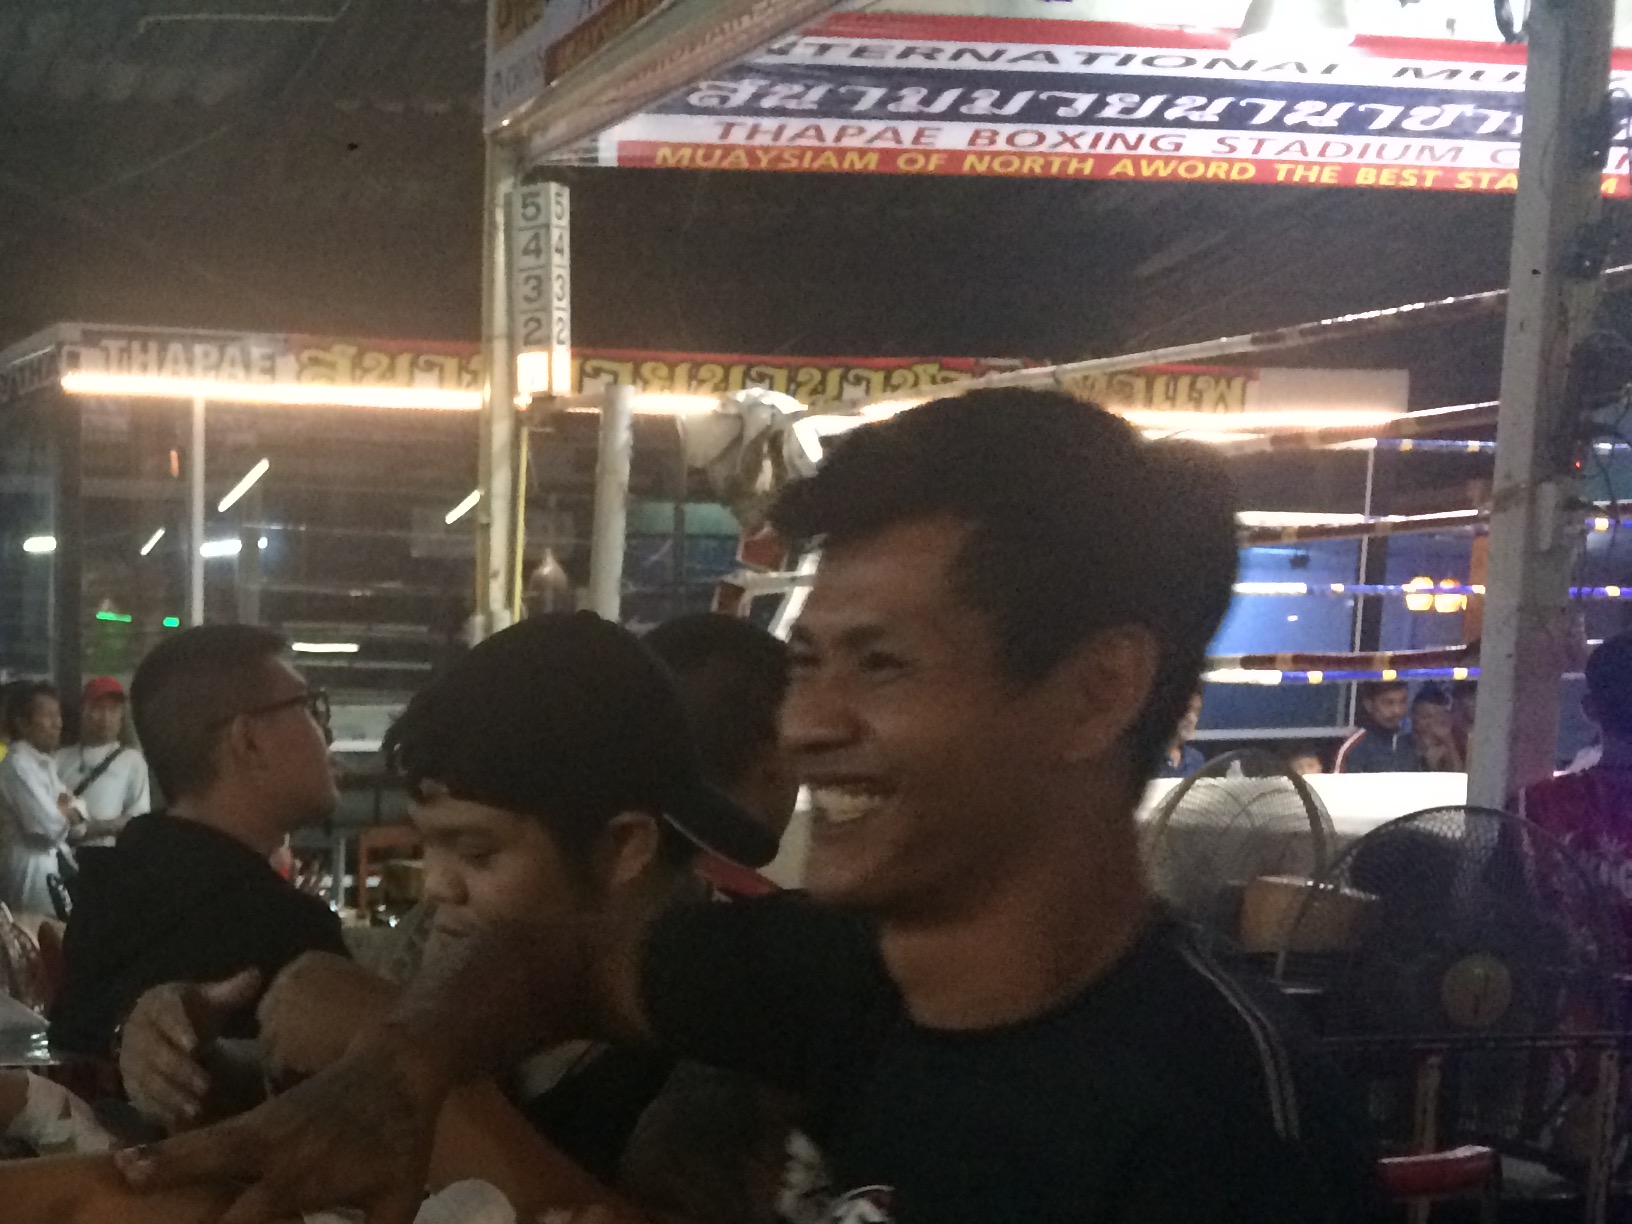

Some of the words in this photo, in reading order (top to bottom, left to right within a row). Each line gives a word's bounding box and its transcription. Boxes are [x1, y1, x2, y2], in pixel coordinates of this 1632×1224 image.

[716, 121, 942, 148] THAPAE
[967, 127, 1187, 154] BOXING
[1212, 134, 1465, 163] STADIUM
[655, 146, 879, 171] MUAYSIAM
[896, 152, 948, 172] OF
[963, 154, 1093, 176] NORTH
[1109, 158, 1256, 182] AWORD
[1274, 162, 1341, 184] THE
[1355, 166, 1444, 189] BEST
[521, 191, 542, 222] 5
[555, 192, 565, 220] 5
[521, 231, 543, 260] 4
[554, 233, 564, 257] 4
[523, 275, 542, 304] 3
[555, 274, 565, 303] 3
[523, 316, 544, 346] 2
[555, 317, 566, 346] 2
